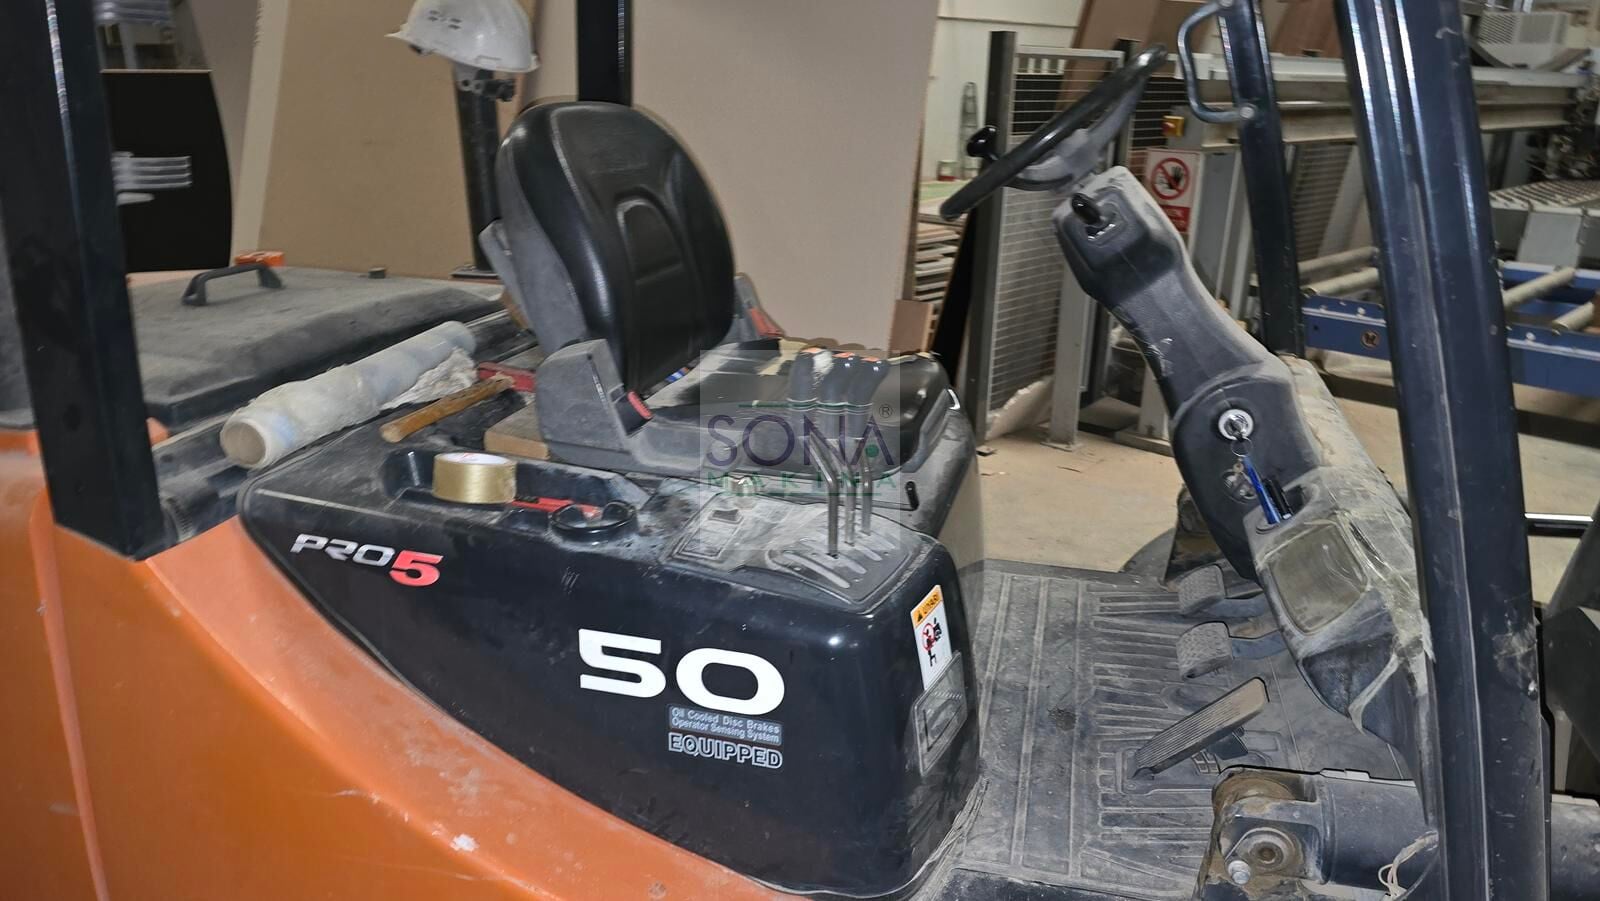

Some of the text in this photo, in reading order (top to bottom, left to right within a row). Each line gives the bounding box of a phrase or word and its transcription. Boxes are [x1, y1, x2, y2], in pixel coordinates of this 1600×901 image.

[578, 628, 785, 716] 50
[671, 707, 780, 734] Oil Cooled Disc Brakes
[671, 717, 780, 743] Operator Sensing System
[668, 732, 783, 769] EQUIPPED
